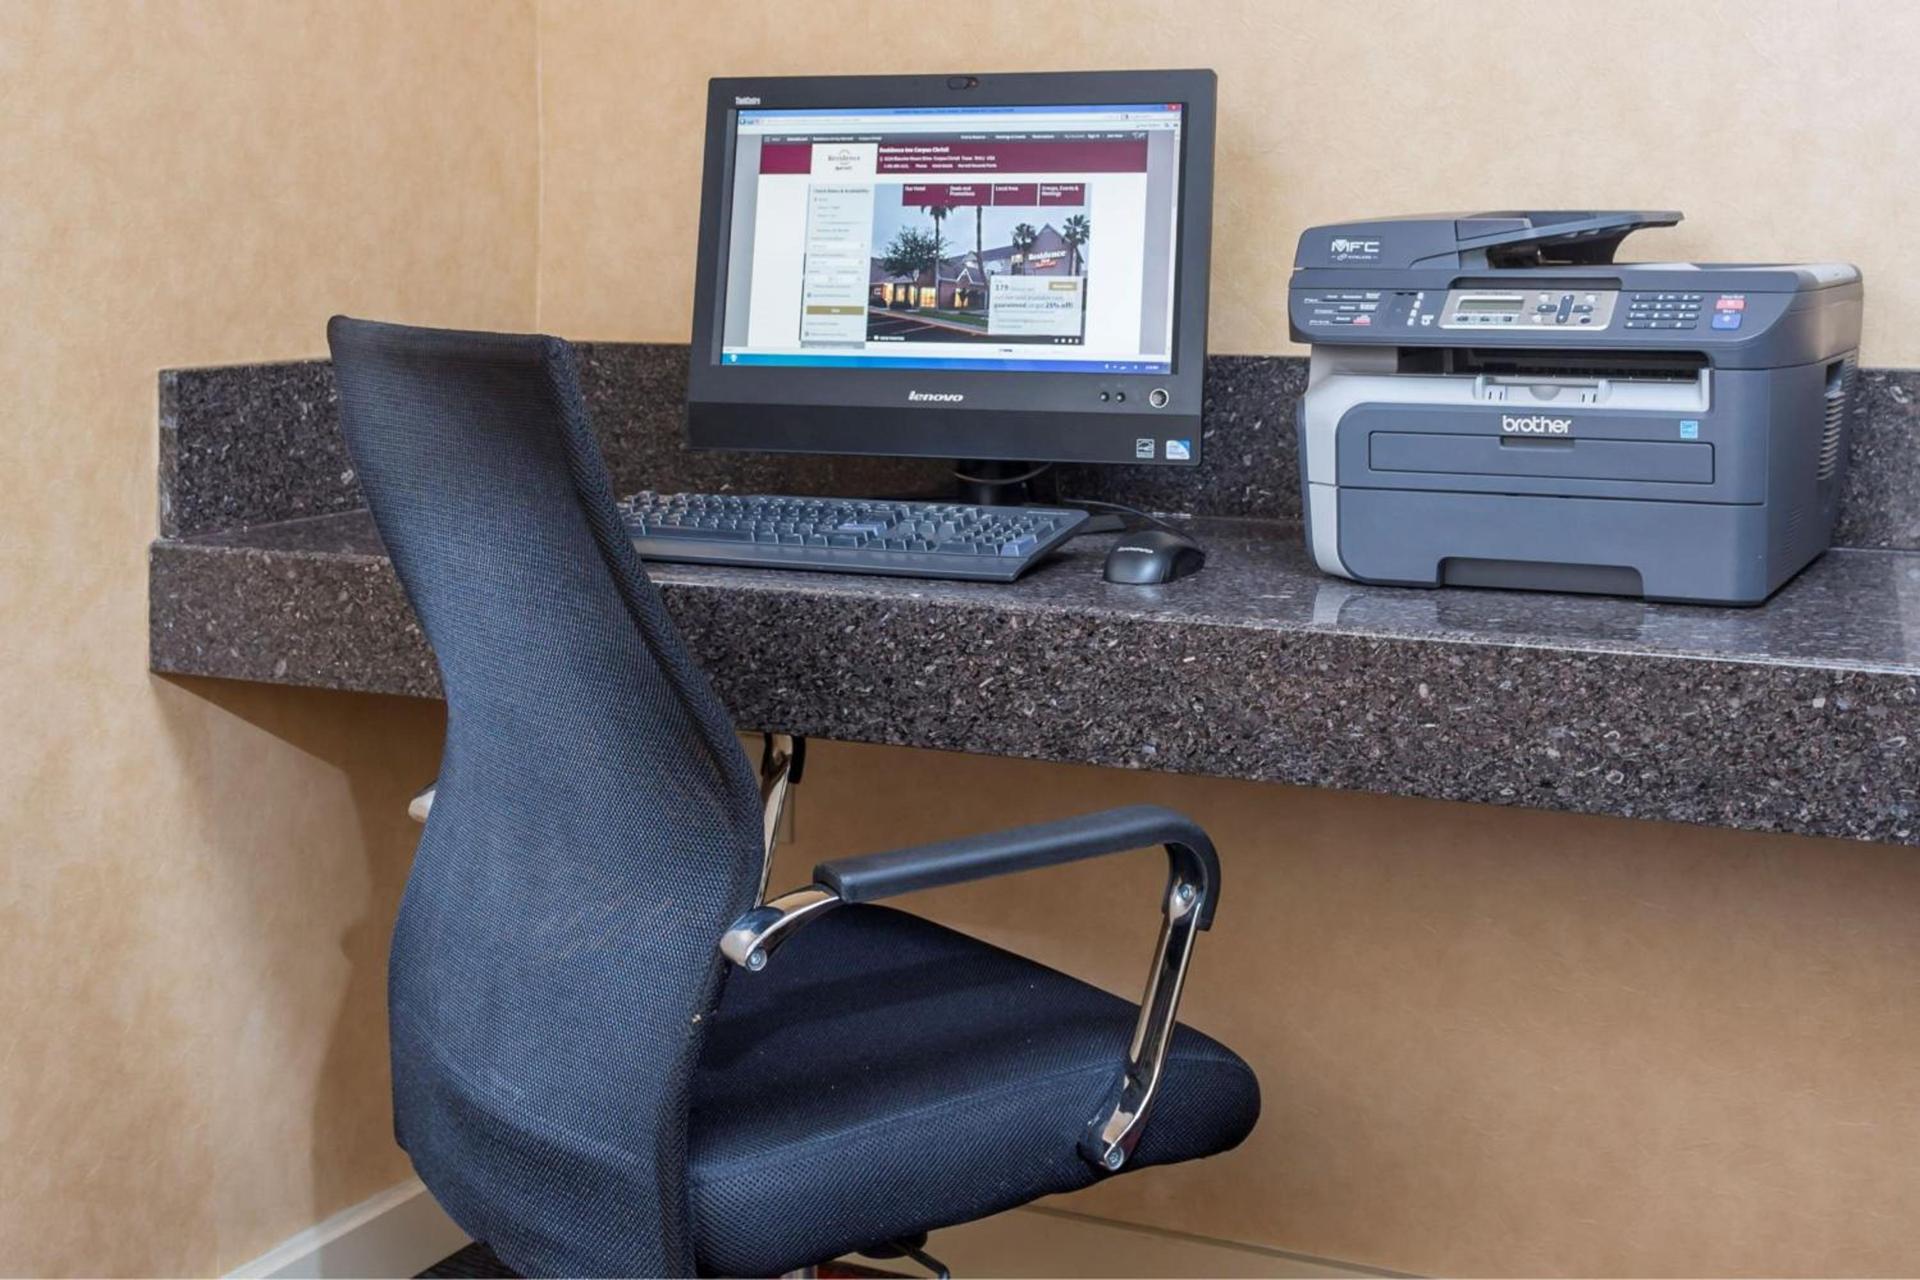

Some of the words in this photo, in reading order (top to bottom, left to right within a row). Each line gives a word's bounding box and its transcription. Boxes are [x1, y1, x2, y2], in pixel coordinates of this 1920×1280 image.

[1331, 239, 1380, 253] MFC
[908, 390, 964, 402] lenovo
[1502, 415, 1572, 433] brother
